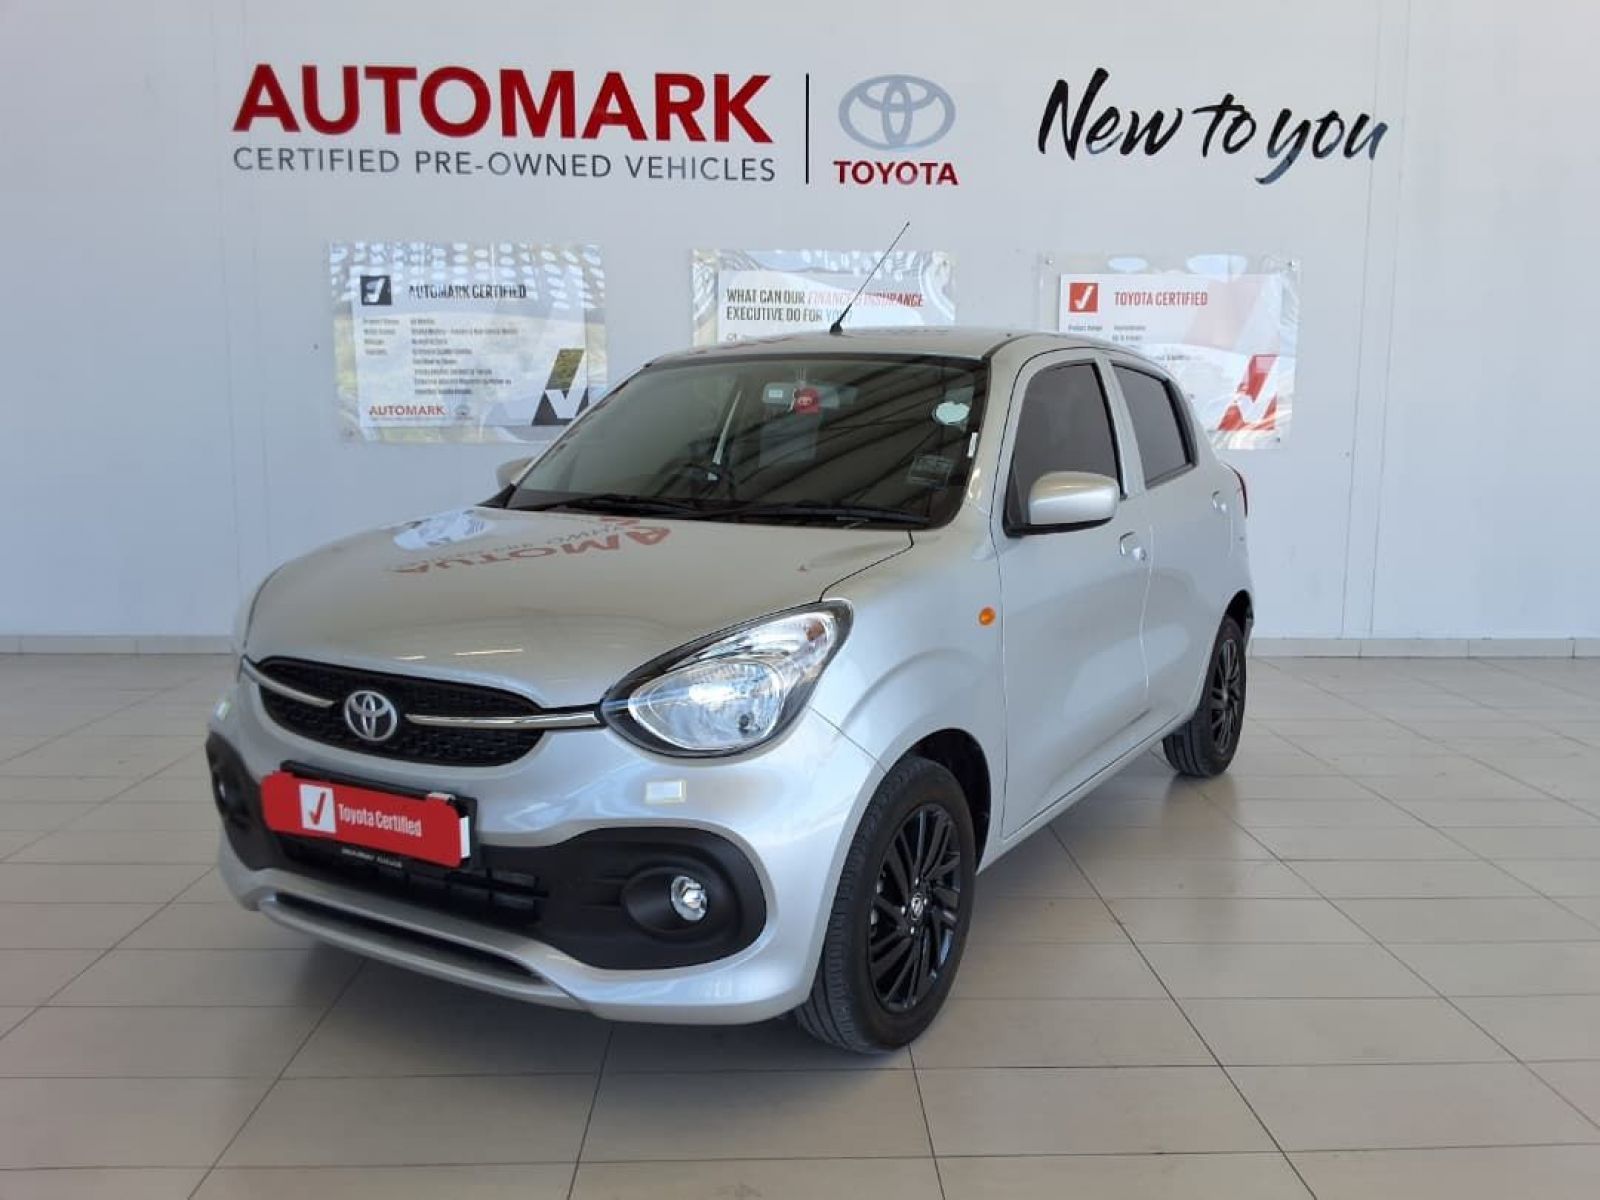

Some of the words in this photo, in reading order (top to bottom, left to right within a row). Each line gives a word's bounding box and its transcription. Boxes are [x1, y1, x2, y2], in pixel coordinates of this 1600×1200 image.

[232, 63, 774, 143] AUTOMARK
[1037, 67, 1183, 160] New
[1191, 93, 1256, 157] to
[1254, 107, 1389, 185] you
[233, 146, 400, 173] CERTIFIED
[415, 150, 612, 179] PRE-OWNED
[624, 154, 777, 182] VEHICLES
[833, 160, 959, 186] TOYOTA
[408, 283, 470, 298] AUTOMARK
[472, 283, 527, 299] CERTIFIED
[726, 288, 758, 303] WHAT
[760, 289, 782, 305] CAN
[784, 290, 805, 306] OUR
[1114, 291, 1152, 306] TOYOTA
[1155, 291, 1209, 306] CERTIFIED
[726, 306, 784, 321] EXECUTIVE
[786, 307, 801, 322] DO
[803, 308, 823, 323] FOR
[368, 405, 446, 417] AUTOMARK
[338, 803, 374, 828] Toyota
[375, 810, 422, 838] Certified
